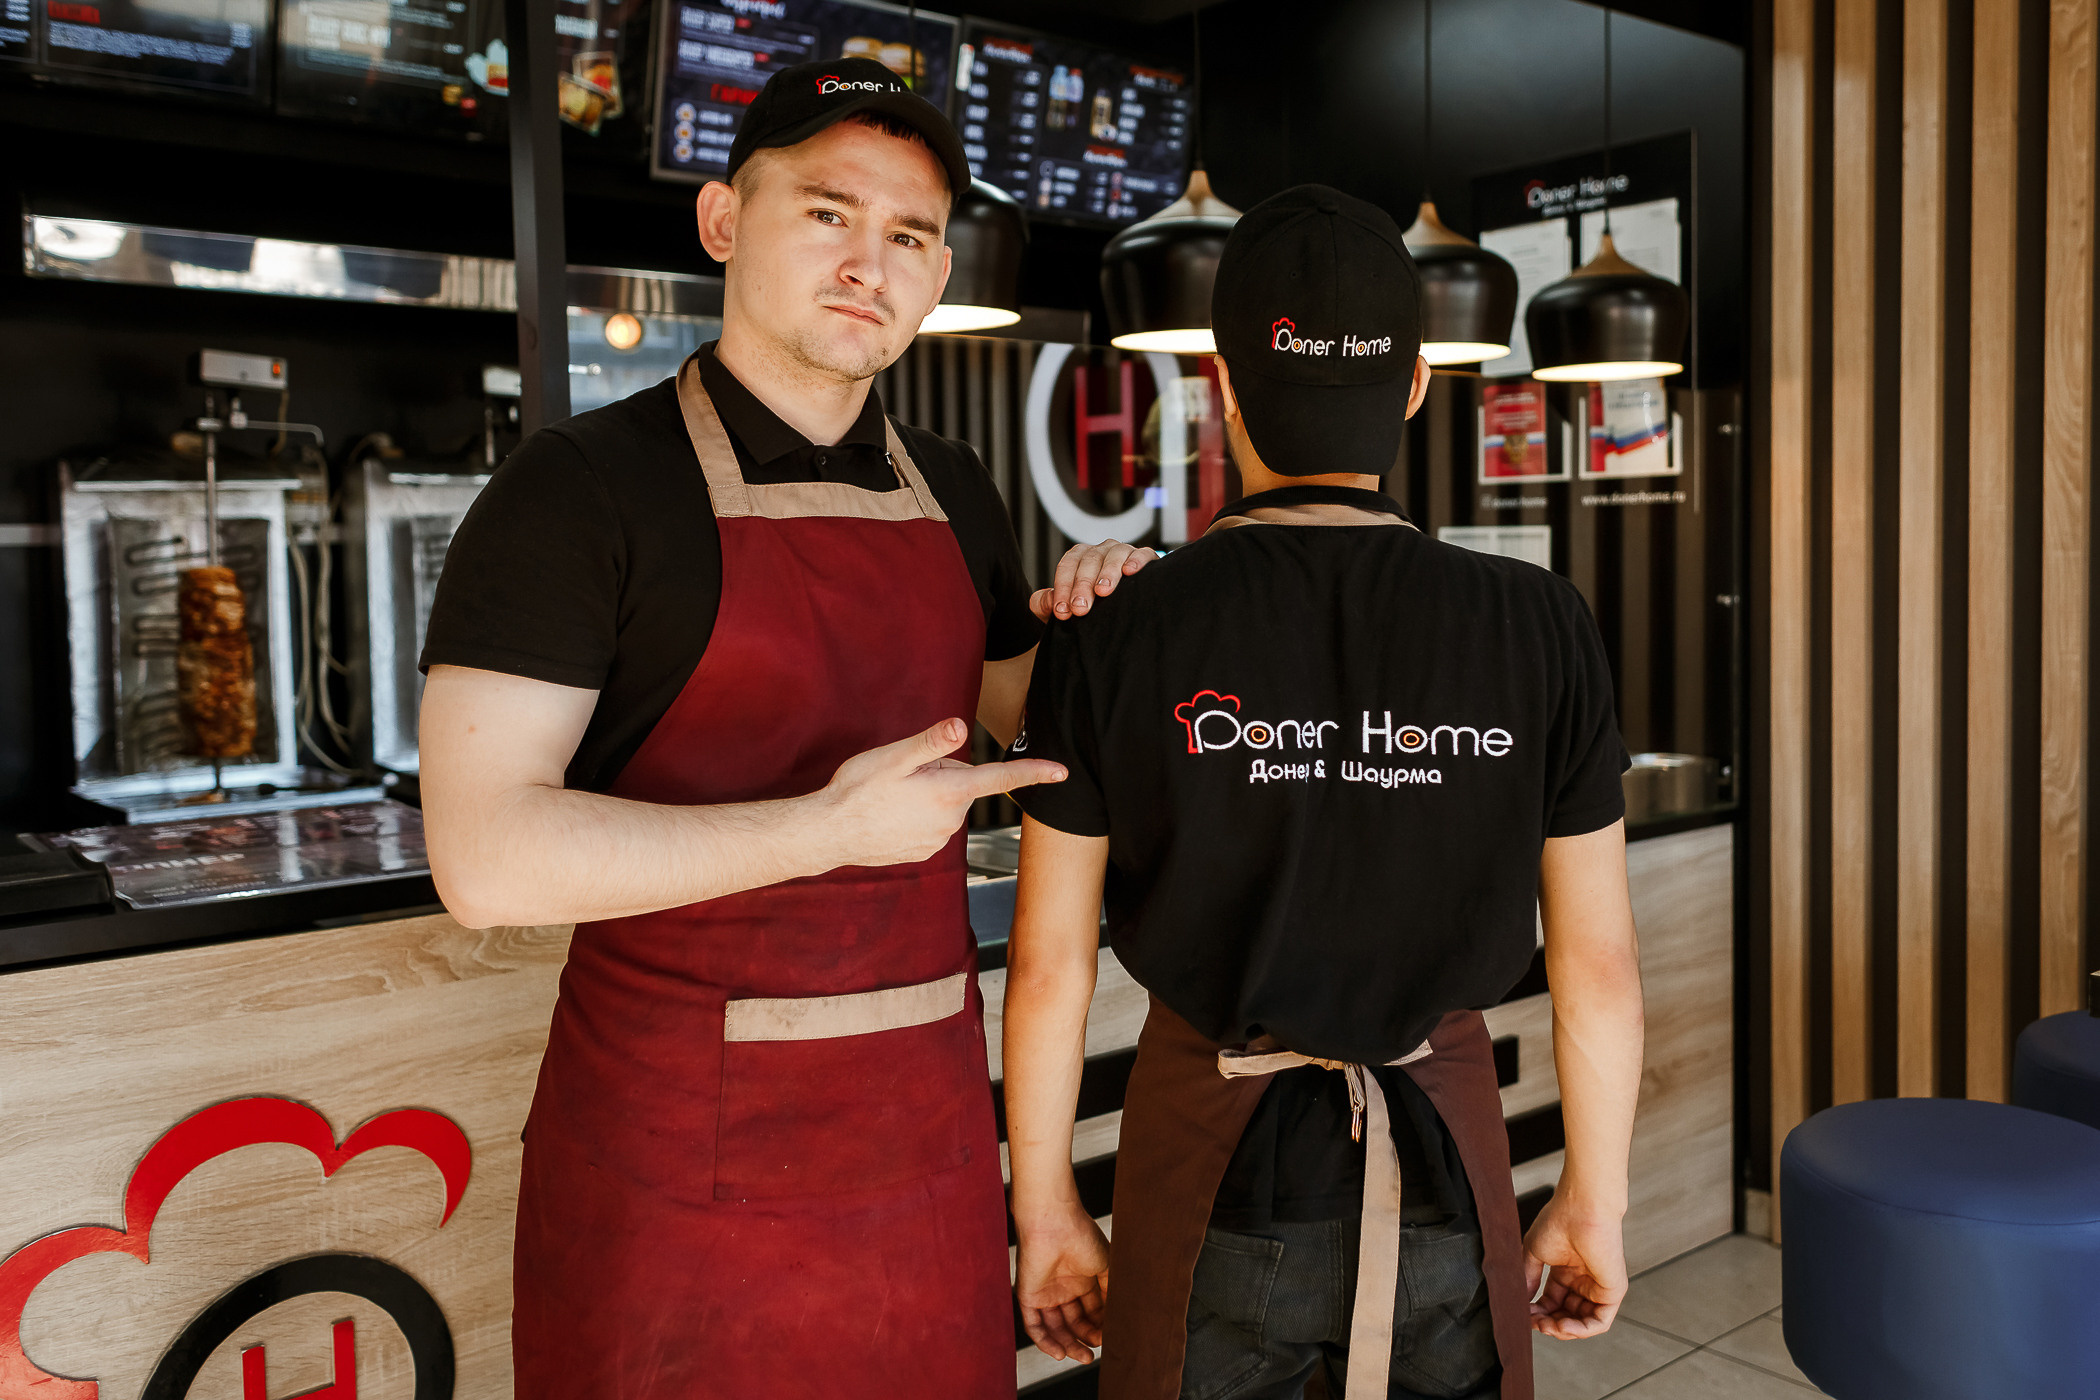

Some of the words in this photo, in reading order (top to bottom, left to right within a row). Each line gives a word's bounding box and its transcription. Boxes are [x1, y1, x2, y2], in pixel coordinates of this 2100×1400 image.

[821, 80, 884, 94] Doner
[1274, 328, 1336, 356] Doner
[1343, 335, 1391, 357] Home
[1193, 709, 1339, 754] Doner
[1362, 710, 1514, 757] Home
[1314, 759, 1326, 779] &
[1341, 760, 1442, 788] Шаурма
